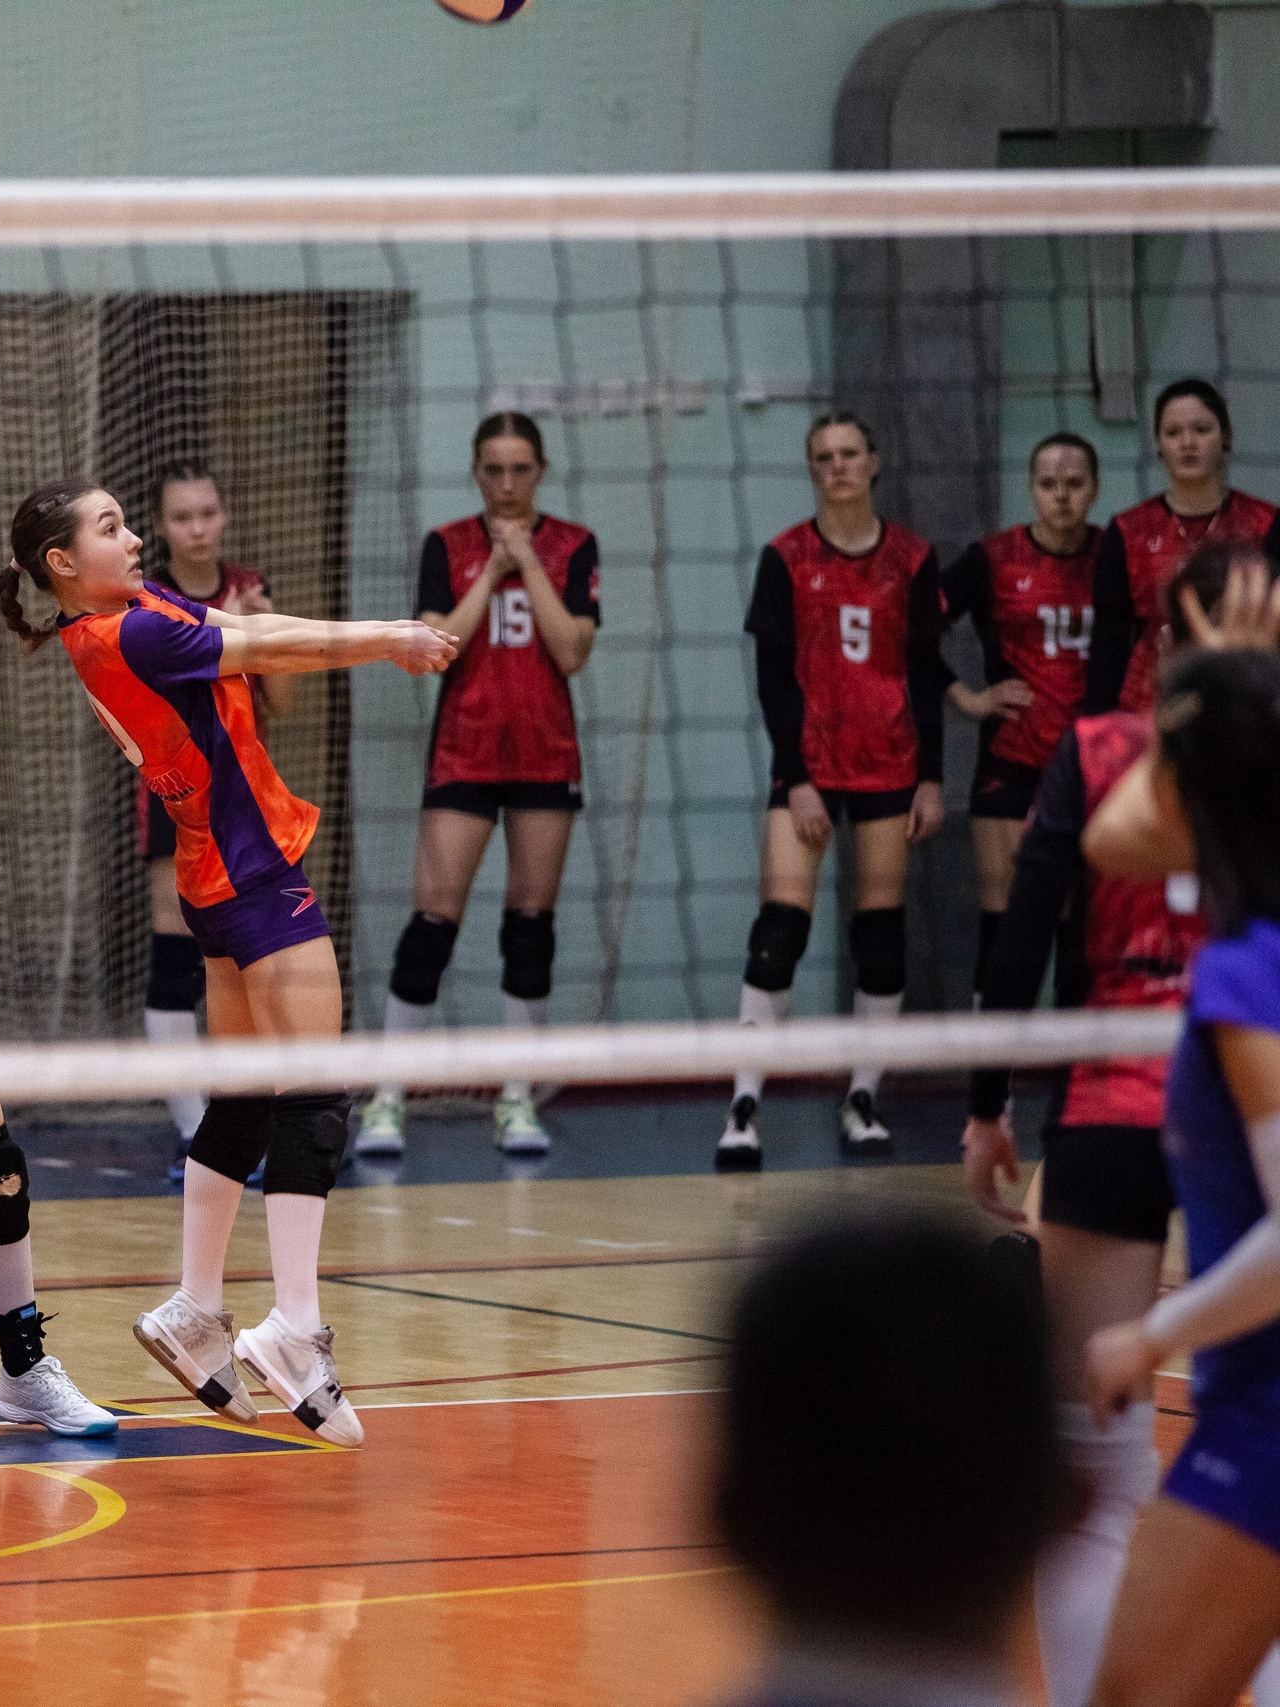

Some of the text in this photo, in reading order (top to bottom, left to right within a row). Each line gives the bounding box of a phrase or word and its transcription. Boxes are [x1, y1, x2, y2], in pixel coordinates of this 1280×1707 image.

[488, 588, 534, 647] 15
[839, 604, 871, 663] 5
[1037, 603, 1095, 659] 14
